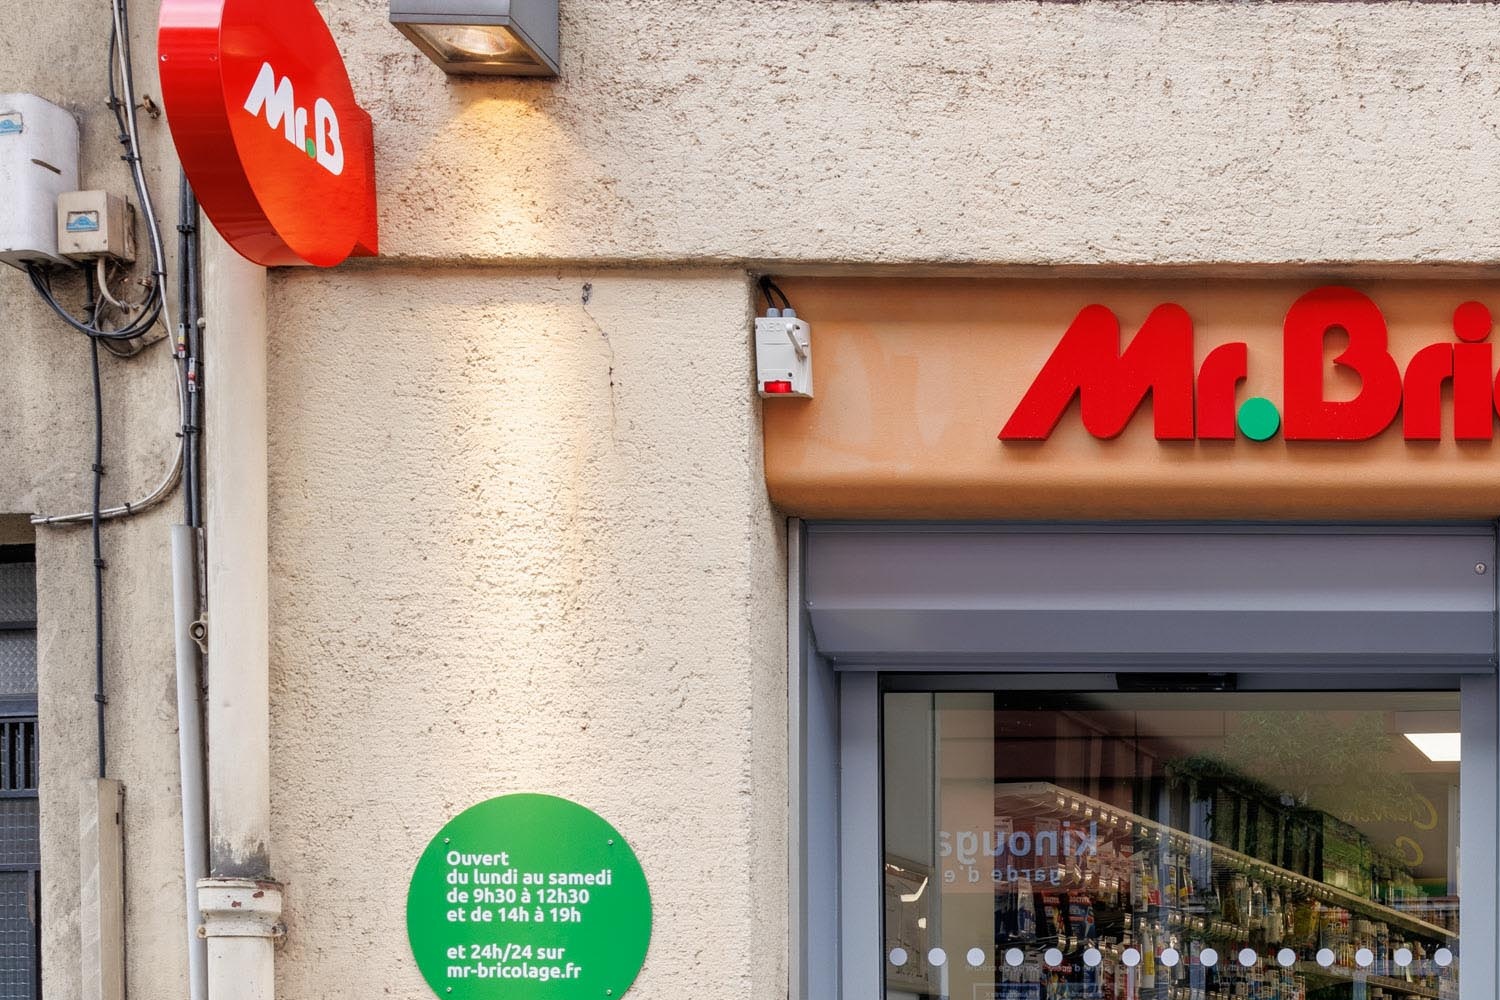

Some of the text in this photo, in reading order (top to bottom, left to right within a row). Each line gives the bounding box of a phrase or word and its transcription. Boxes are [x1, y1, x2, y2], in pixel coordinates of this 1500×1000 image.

[243, 61, 345, 177] Mr.B
[446, 850, 509, 866] Ouvert
[446, 868, 612, 885] du lundi au samedi
[446, 887, 590, 904] de 9h30 à 12h30
[446, 906, 581, 922] et de 14h à 19h
[446, 943, 566, 963] et 24h/24 sur
[447, 962, 582, 982] mr-bricolage.fr
